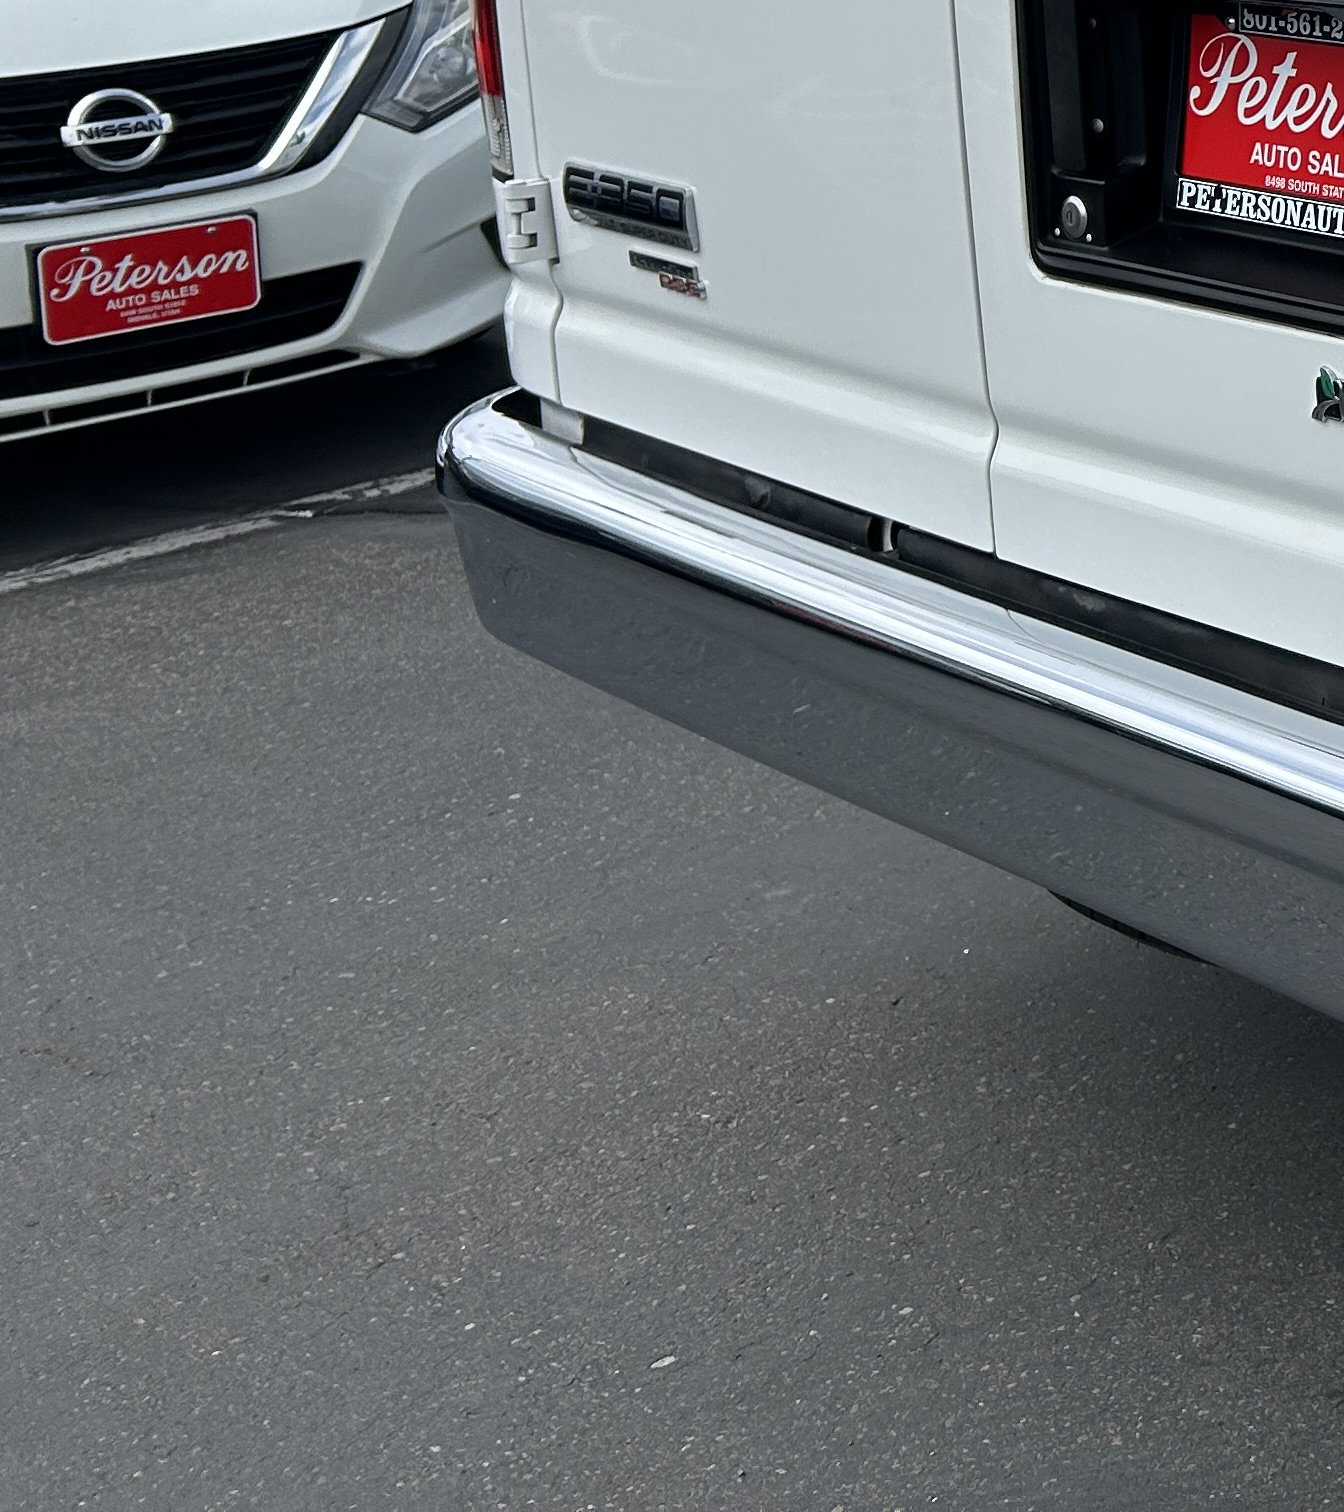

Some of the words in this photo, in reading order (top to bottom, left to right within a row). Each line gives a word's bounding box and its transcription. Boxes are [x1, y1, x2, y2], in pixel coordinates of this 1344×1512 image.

[76, 118, 163, 141] NISSAN
[1250, 142, 1301, 171] AUTO
[1264, 175, 1286, 189] 8498
[1288, 179, 1320, 195] SOUTH
[50, 249, 249, 303] Peterson
[105, 293, 146, 311] AUTO
[151, 284, 199, 303] SALES
